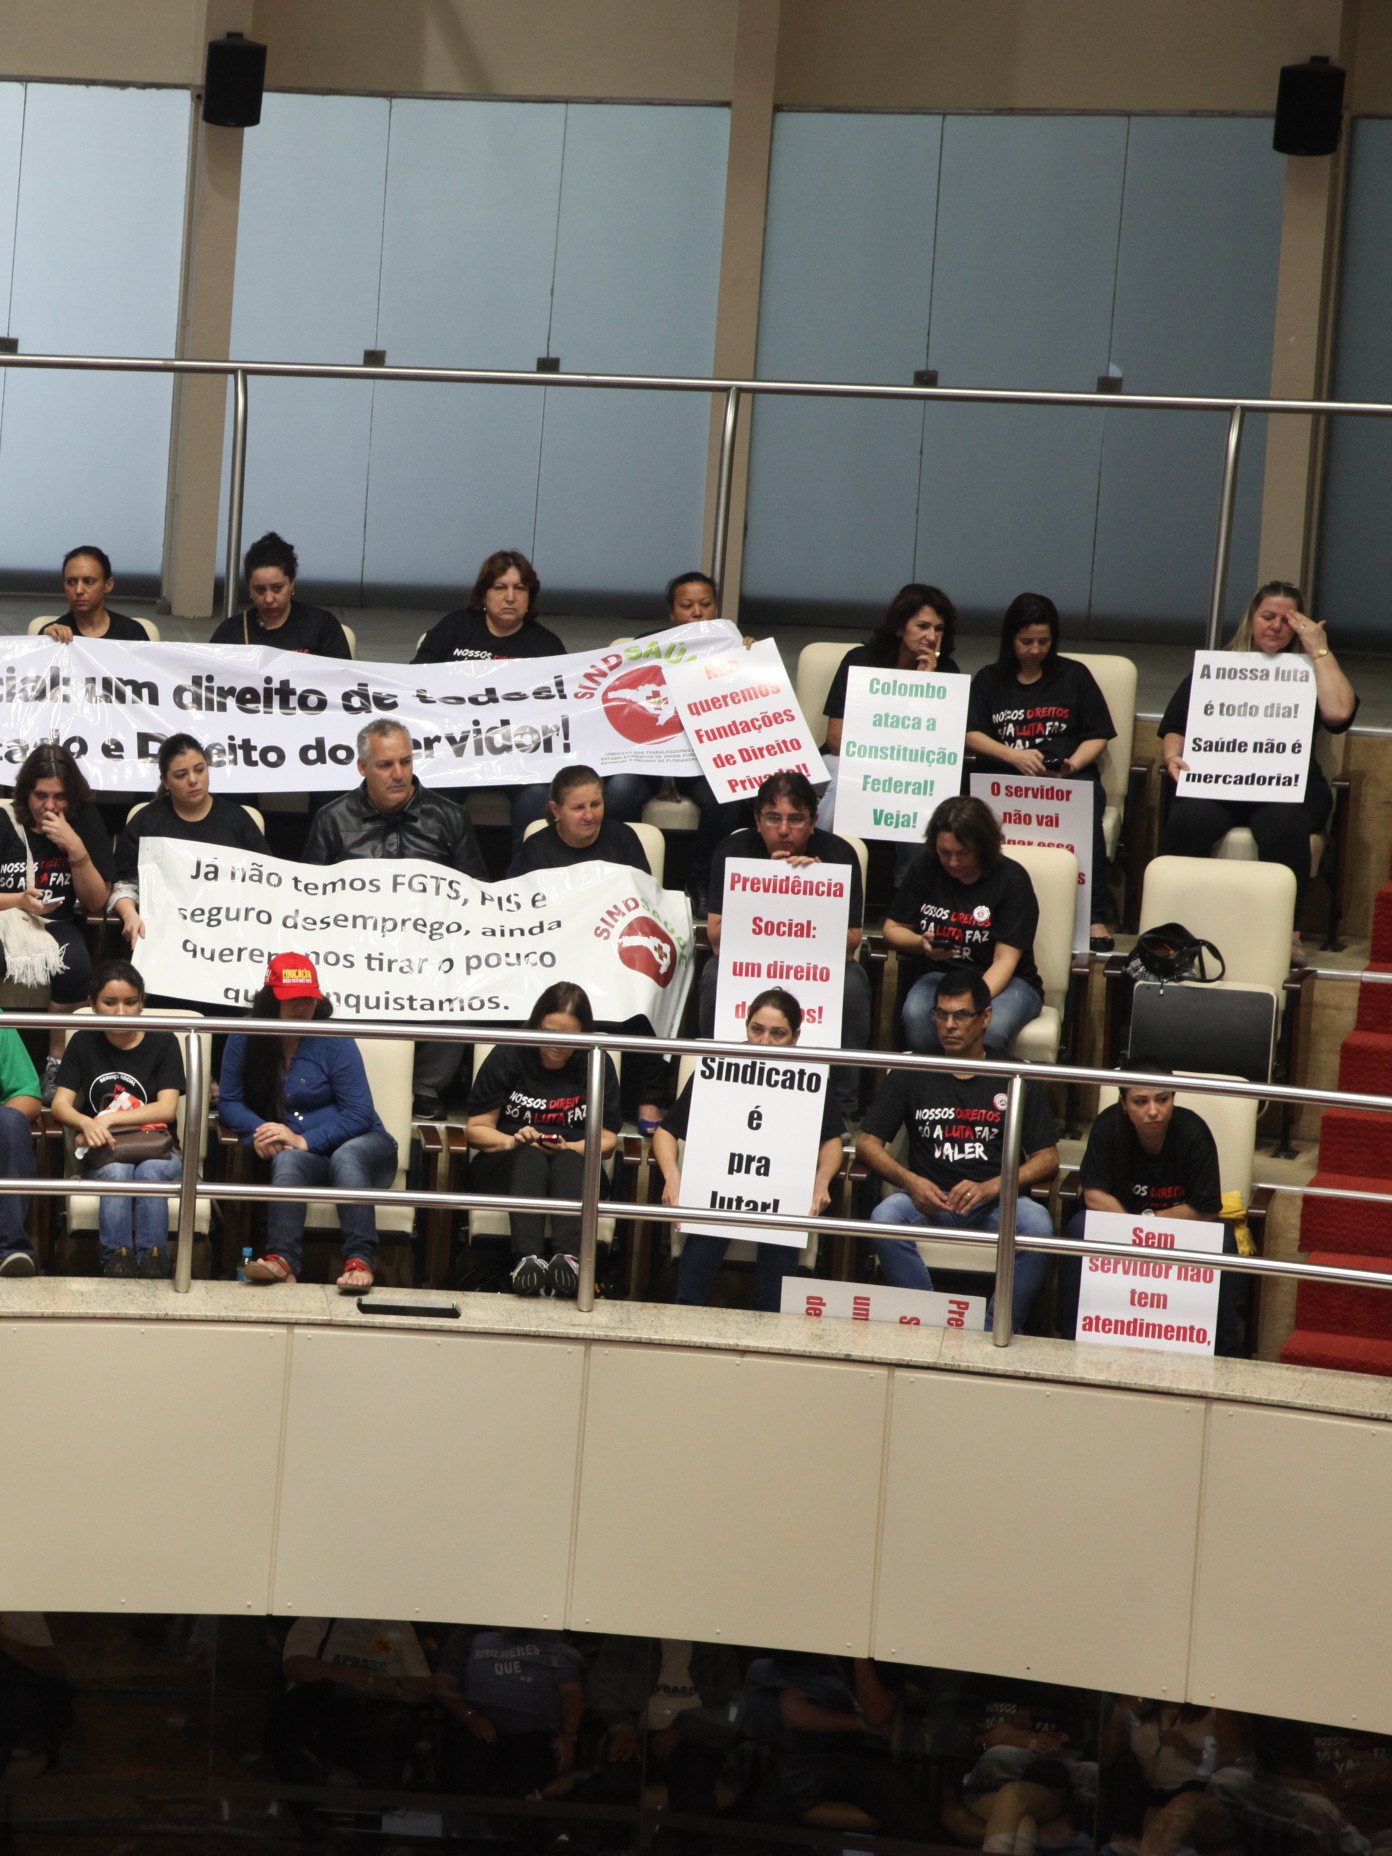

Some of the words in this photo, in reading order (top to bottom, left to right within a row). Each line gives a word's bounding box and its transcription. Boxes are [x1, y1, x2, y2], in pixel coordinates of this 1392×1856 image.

[1199, 664, 1212, 680] A
[1216, 666, 1270, 681] nossa
[1274, 666, 1310, 683] luta
[85, 674, 159, 705] um
[172, 674, 329, 716] direito
[341, 682, 399, 715] de
[687, 681, 782, 717] queremos
[868, 677, 947, 700] Colombo
[1203, 700, 1215, 717] é
[1219, 702, 1259, 718] todo
[1263, 702, 1299, 719] dia!
[694, 708, 796, 745] Fundações
[872, 711, 922, 731] ataca
[925, 715, 937, 732] a
[100, 736, 125, 760] e
[136, 730, 287, 769] Deito
[298, 736, 355, 767] do
[411, 714, 572, 760] ervidor!
[1191, 736, 1248, 754] Saúde
[1252, 738, 1287, 754] não
[1291, 739, 1303, 755] é
[712, 748, 737, 770] de
[738, 737, 802, 764] Direito
[845, 740, 958, 767] Constituição
[861, 774, 935, 797] Federal!
[1185, 772, 1300, 787] mercadoria!
[990, 781, 1001, 797] O
[1004, 784, 1073, 802] servidor
[872, 808, 918, 829] Veja!
[1002, 808, 1033, 826] não
[1035, 812, 1060, 828] vai
[190, 857, 219, 882] Já
[230, 863, 283, 888] não
[291, 873, 381, 896] temos
[392, 872, 470, 908] FGTS,
[531, 891, 548, 910] e
[729, 872, 845, 898] Previdência
[178, 905, 272, 928] seguro
[281, 908, 471, 941] desemprego,
[481, 918, 563, 938] ainda
[751, 916, 817, 939] Social:
[965, 930, 990, 943] FAZ
[364, 952, 429, 975] tirar
[438, 956, 455, 974] o
[465, 950, 557, 975] pouco
[732, 961, 762, 979] um
[766, 961, 831, 982] direito
[700, 1056, 822, 1093] Sindicato
[509, 1090, 547, 1110] NOSSOS
[505, 1104, 520, 1118] SÓ
[523, 1110, 533, 1124] A
[747, 1105, 763, 1131] é
[915, 1107, 955, 1121] NOSSOS
[956, 1108, 1001, 1123] DIREITOS
[933, 1125, 943, 1140] A
[944, 1124, 975, 1139] LUTA
[975, 1125, 999, 1139] FAZ
[934, 1142, 988, 1163] VALER
[727, 1151, 771, 1178] pra
[1131, 1226, 1176, 1249] Sem
[1129, 1288, 1168, 1310] tem
[1081, 1314, 1211, 1347] atendimento,
